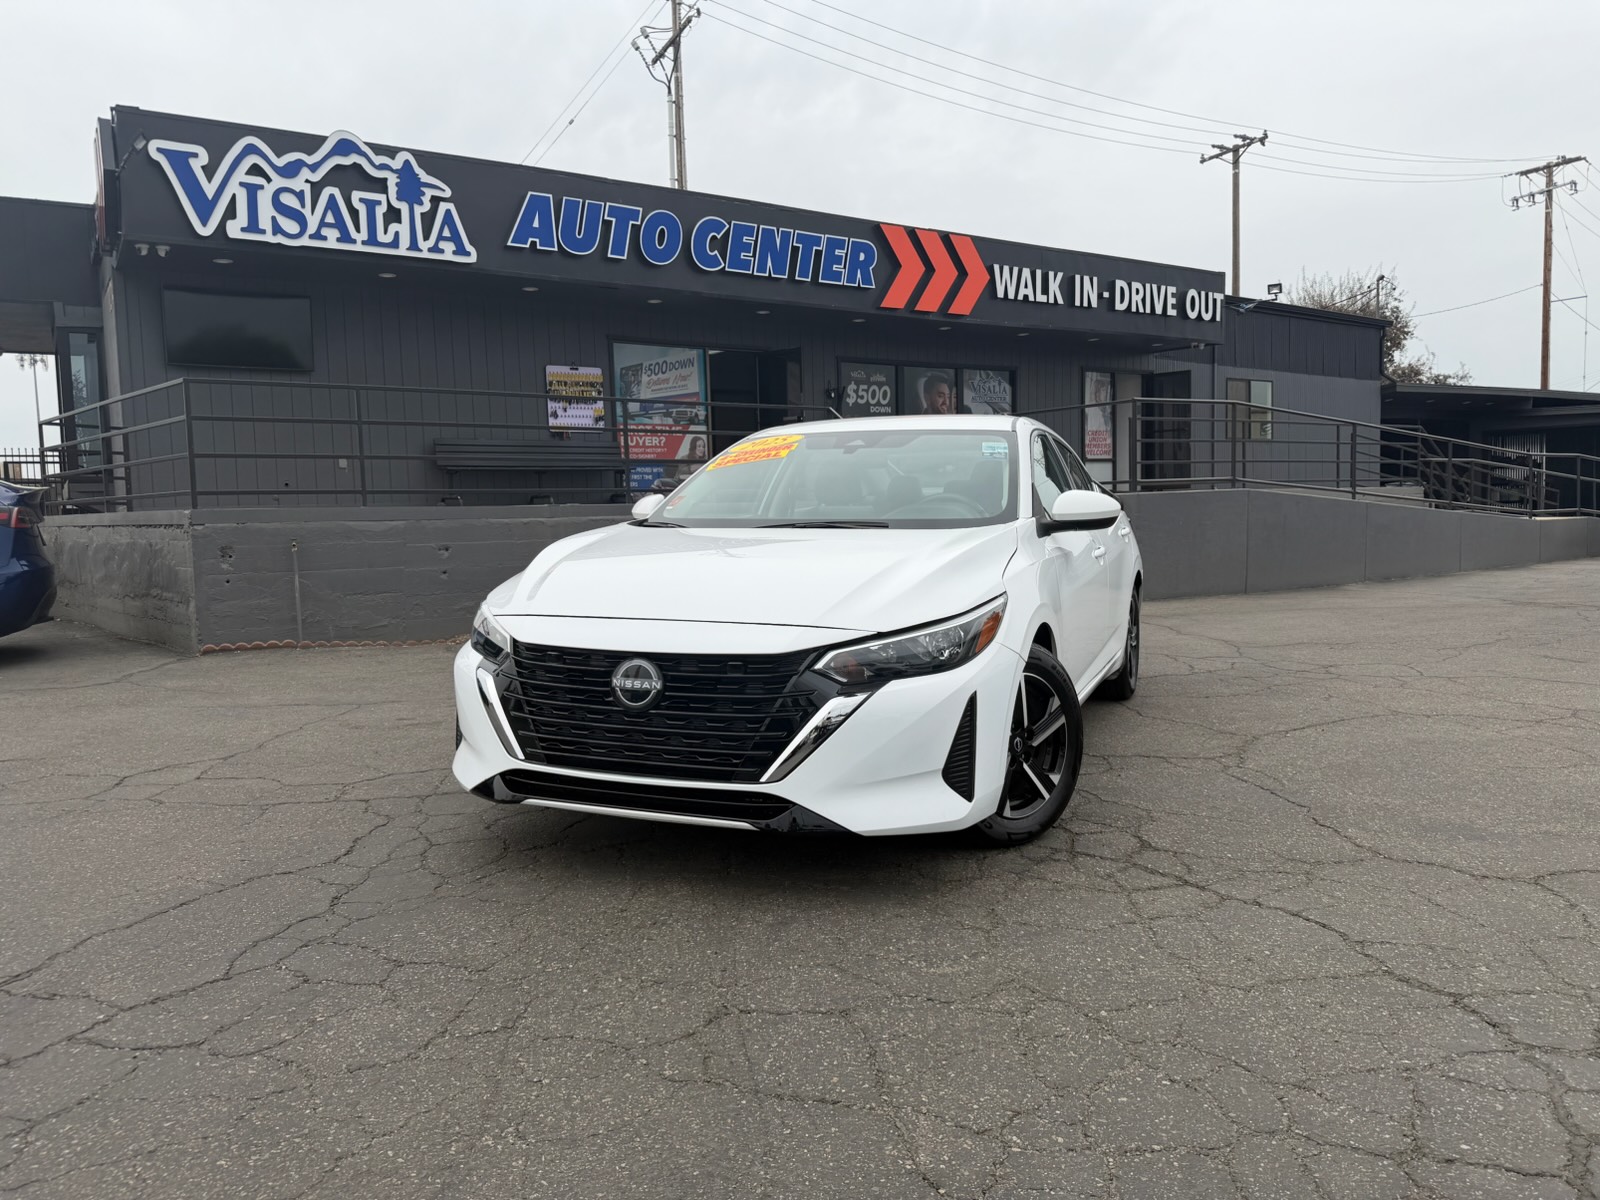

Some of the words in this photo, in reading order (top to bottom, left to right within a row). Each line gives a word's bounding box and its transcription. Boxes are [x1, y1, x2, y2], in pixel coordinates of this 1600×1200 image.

[152, 138, 475, 260] VISALIA
[507, 191, 683, 265] AUTO
[691, 216, 878, 289] CENTER
[993, 264, 1064, 305] WALK
[1075, 274, 1098, 309] IN
[1115, 279, 1177, 317] DRIVE
[1185, 288, 1224, 322] OUT
[644, 360, 668, 378] $500
[669, 357, 695, 372] DOWN
[846, 381, 891, 407] $500
[870, 406, 892, 414] DOWN
[612, 679, 660, 689] NISSAN
